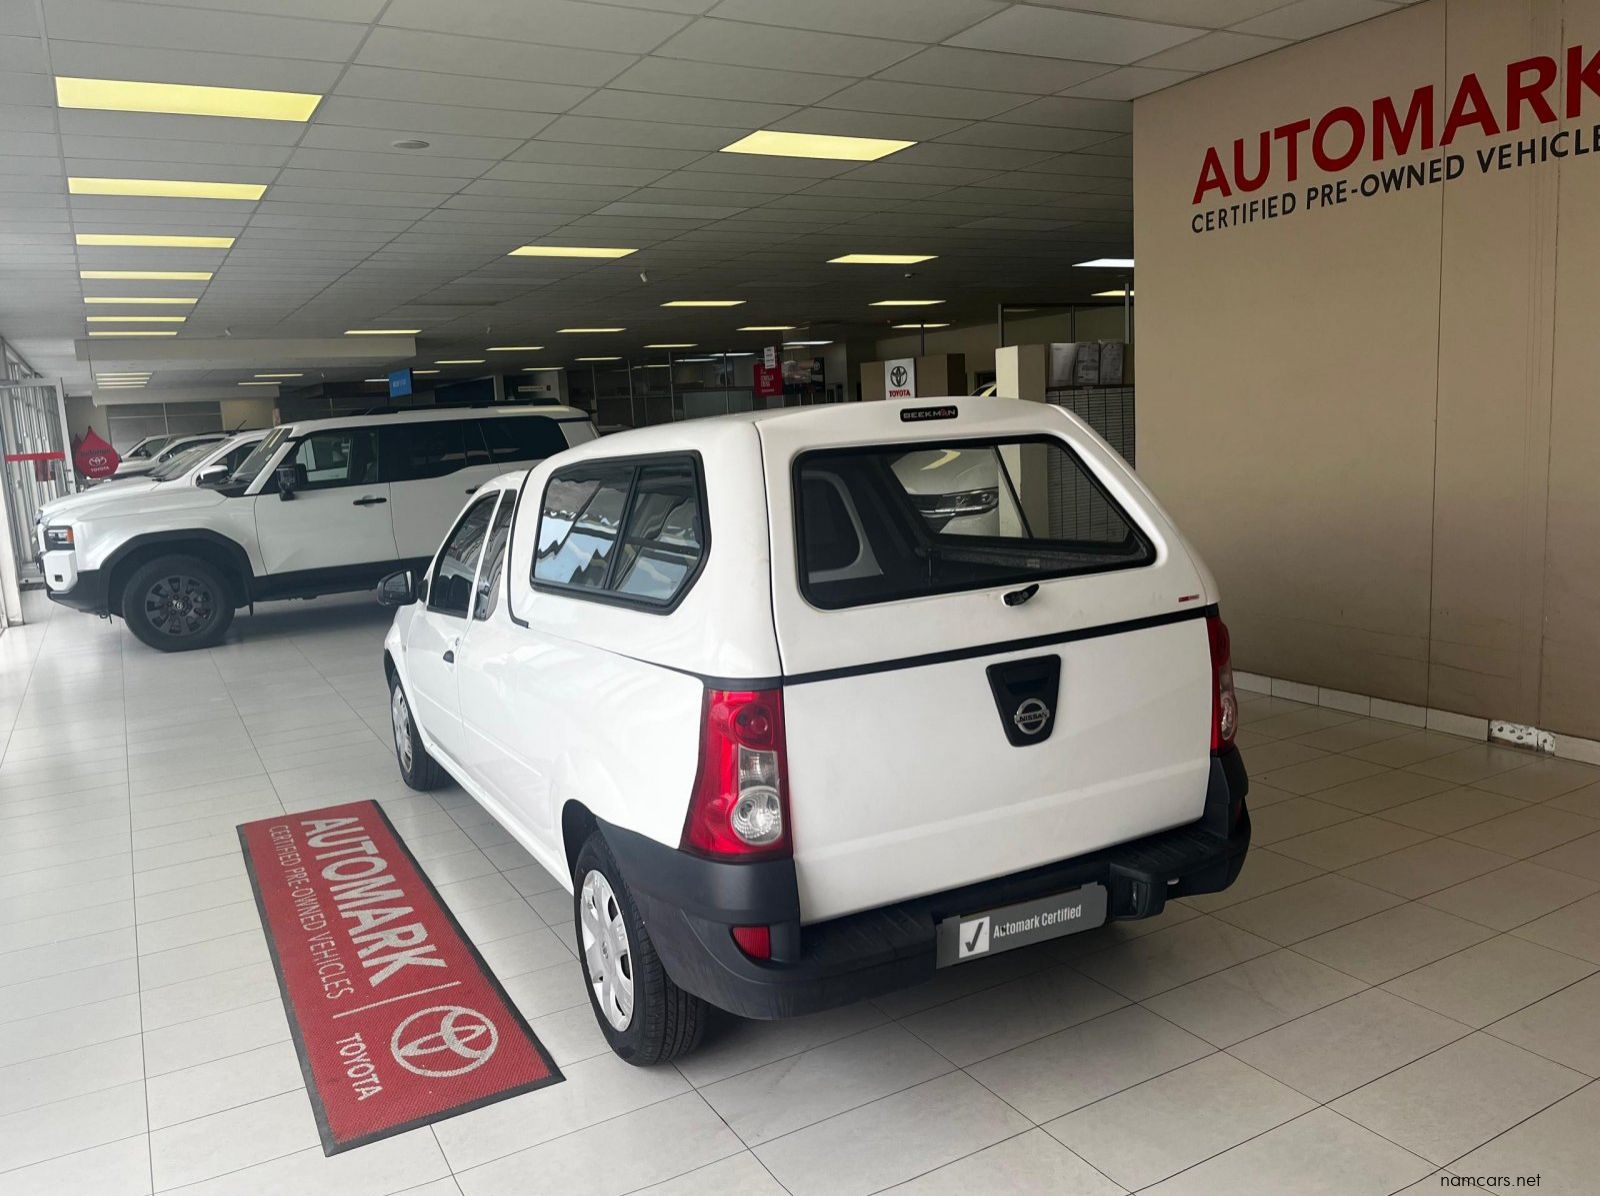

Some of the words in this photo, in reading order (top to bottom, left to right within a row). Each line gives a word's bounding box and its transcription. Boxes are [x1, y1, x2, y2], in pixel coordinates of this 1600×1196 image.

[1192, 45, 1600, 204] AUTOMARK
[1191, 192, 1296, 234] CERTIFIED
[1306, 154, 1465, 210] PRE-OWNED
[889, 389, 911, 398] TOYOTA
[903, 409, 956, 419] BEEKMAN
[1019, 712, 1047, 721] NISSAN
[268, 824, 301, 866] CERTIFIED
[285, 865, 327, 931] PRE-OWNED
[307, 929, 355, 1000] VEHICLES
[301, 818, 447, 986] AUTOMARK
[993, 915, 1040, 940] Automark
[1041, 904, 1082, 927] Certified
[335, 1032, 383, 1102] TOYOTA
